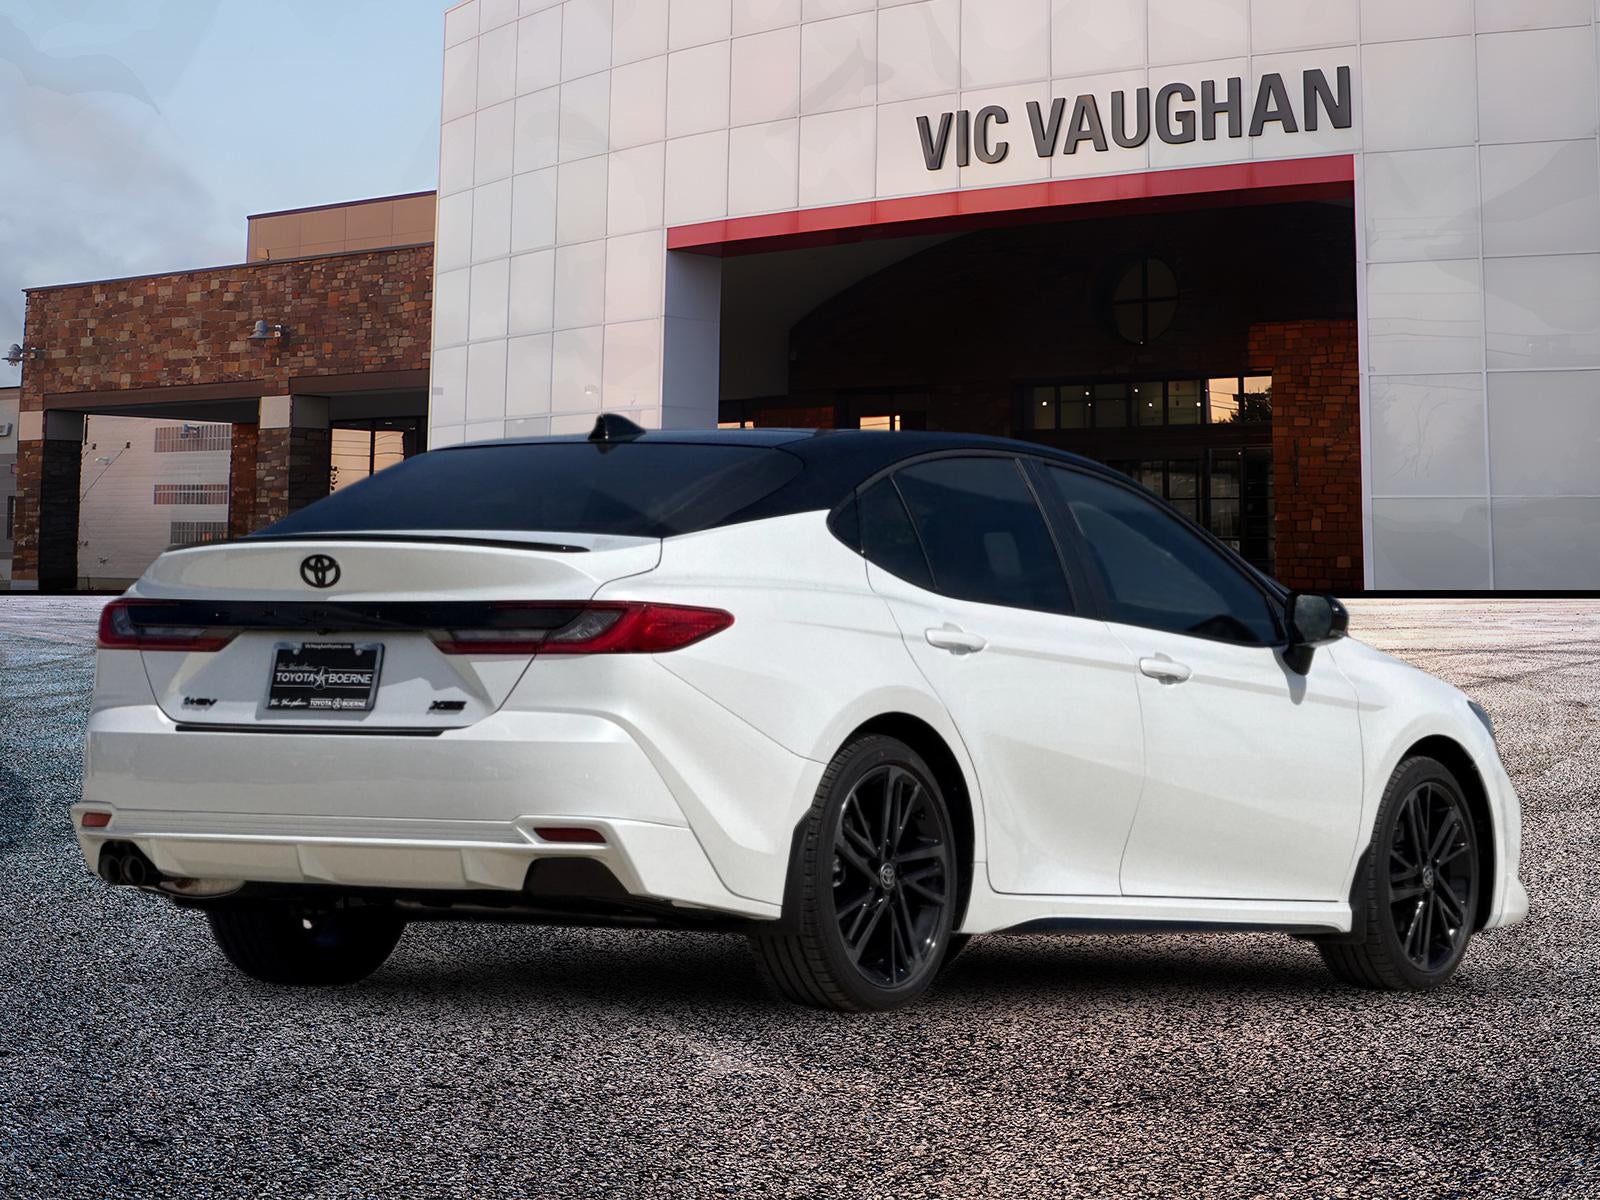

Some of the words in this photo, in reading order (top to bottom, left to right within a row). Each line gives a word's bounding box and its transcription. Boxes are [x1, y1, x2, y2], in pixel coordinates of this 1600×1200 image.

[916, 105, 1009, 171] VIC
[1025, 66, 1352, 157] VAUGHAN
[276, 672, 314, 682] TOYOTA
[329, 673, 372, 683] BOERNE
